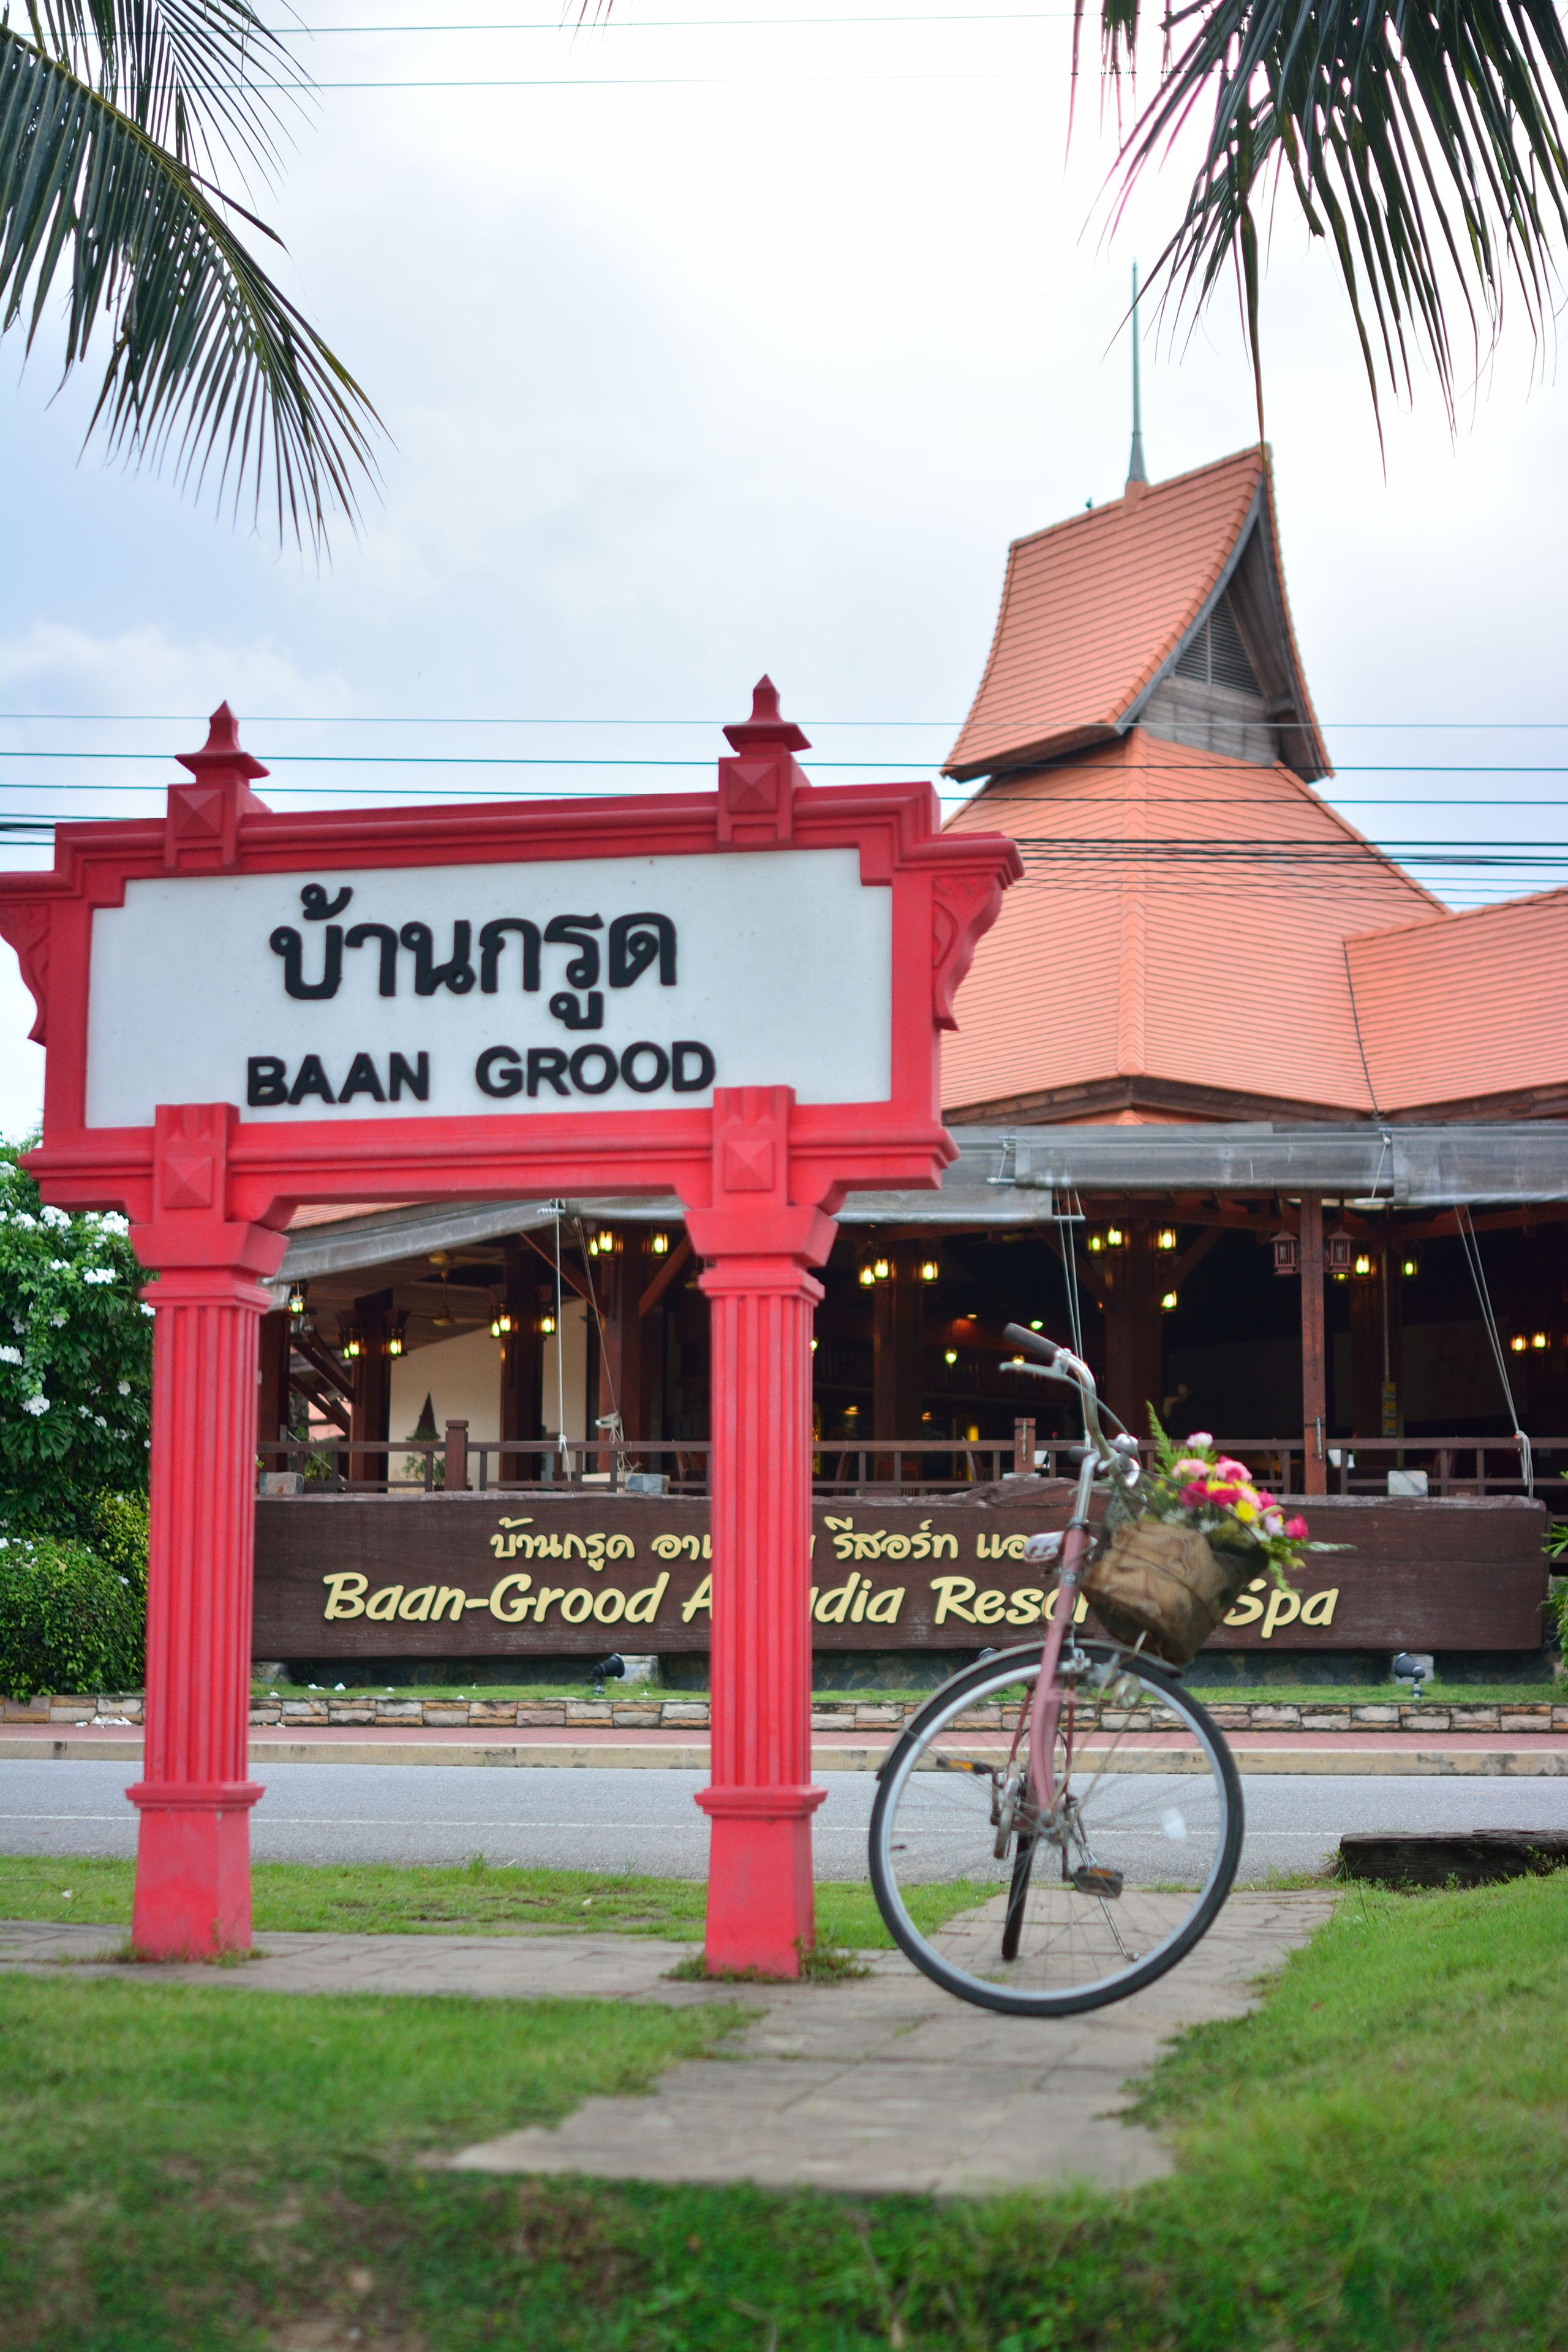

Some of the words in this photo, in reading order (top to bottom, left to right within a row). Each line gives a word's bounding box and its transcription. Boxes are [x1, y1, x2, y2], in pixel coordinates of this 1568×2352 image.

[270, 883, 677, 1030] บ้านกรูด
[247, 1051, 429, 1107] BAAN
[475, 1041, 716, 1098] GROOD
[489, 1517, 635, 1572] บ้านกรูด
[824, 1515, 959, 1560] รีสอร์ท
[322, 1571, 671, 1624] Baan-Grood
[681, 1572, 906, 1624] Adia
[1222, 1577, 1340, 1639] Spa
